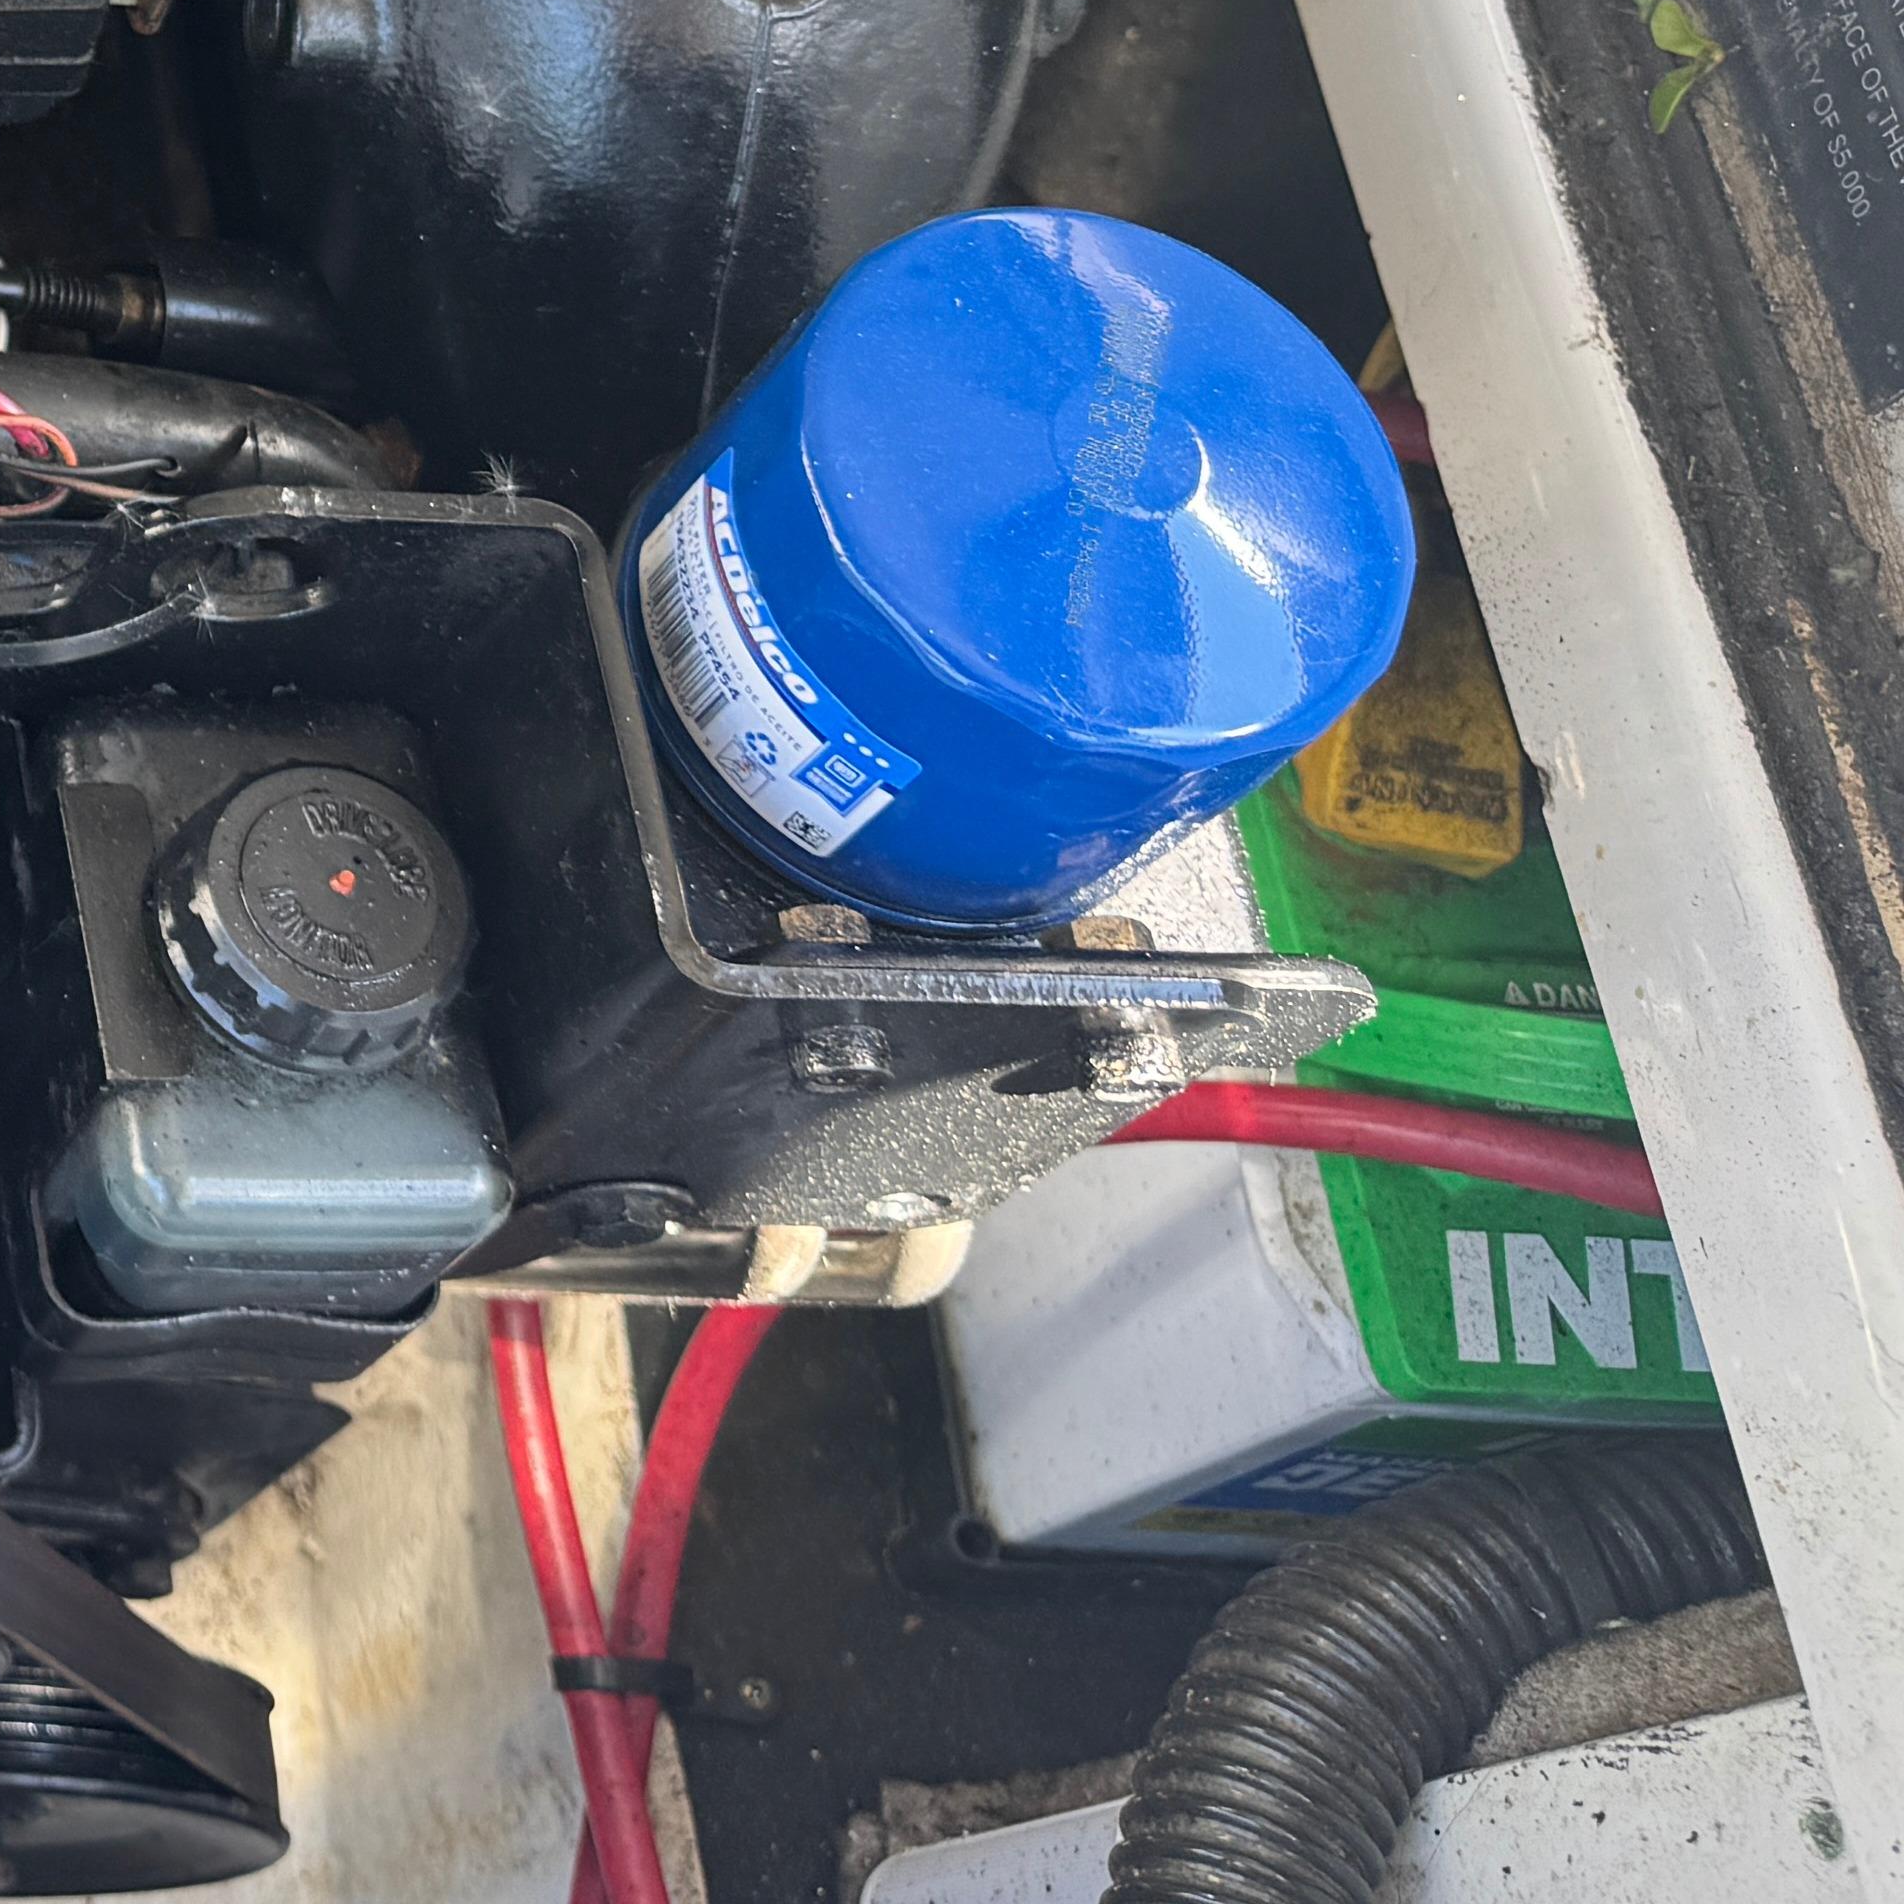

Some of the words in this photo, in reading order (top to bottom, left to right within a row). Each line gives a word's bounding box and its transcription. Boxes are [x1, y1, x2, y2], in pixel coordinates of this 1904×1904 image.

[1813, 91, 1841, 129] OF
[1860, 66, 1890, 103] OF
[1878, 106, 1904, 170] THE
[698, 630, 741, 703] PF454
